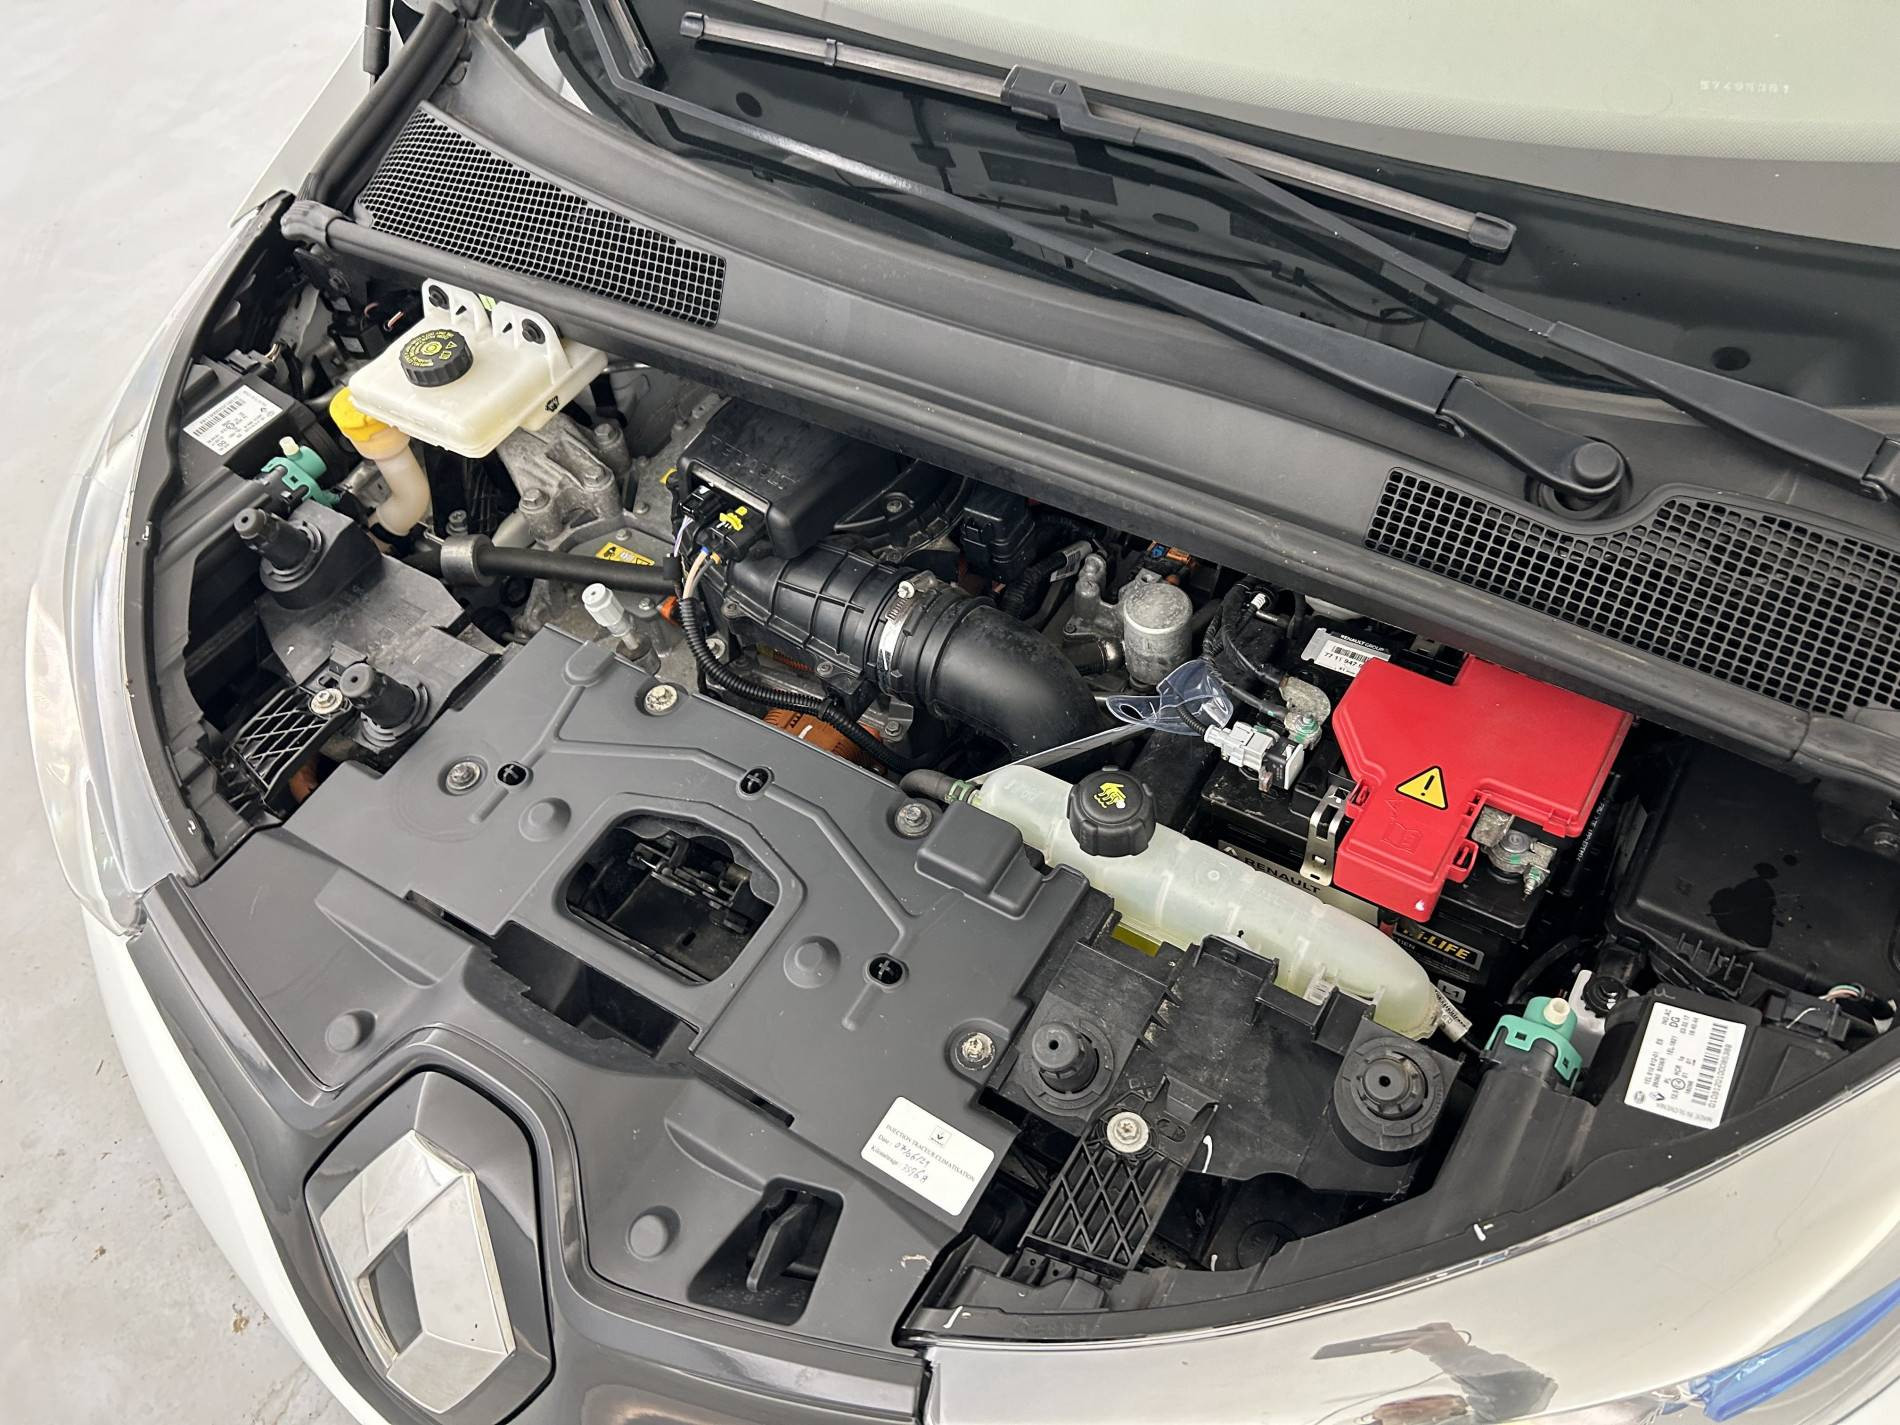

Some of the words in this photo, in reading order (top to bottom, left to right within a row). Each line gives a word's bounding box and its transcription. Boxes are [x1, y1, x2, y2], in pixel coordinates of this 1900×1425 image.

[1340, 633, 1365, 648] RENAULT
[1365, 642, 1385, 652] GROUP
[1343, 657, 1357, 667] 947
[1244, 857, 1321, 894] RENAULT
[1670, 1016, 1680, 1028] DG
[885, 1124, 911, 1143] INJECTION
[912, 1139, 936, 1158] TRACEUR
[935, 1152, 976, 1181] CLIMATISATION
